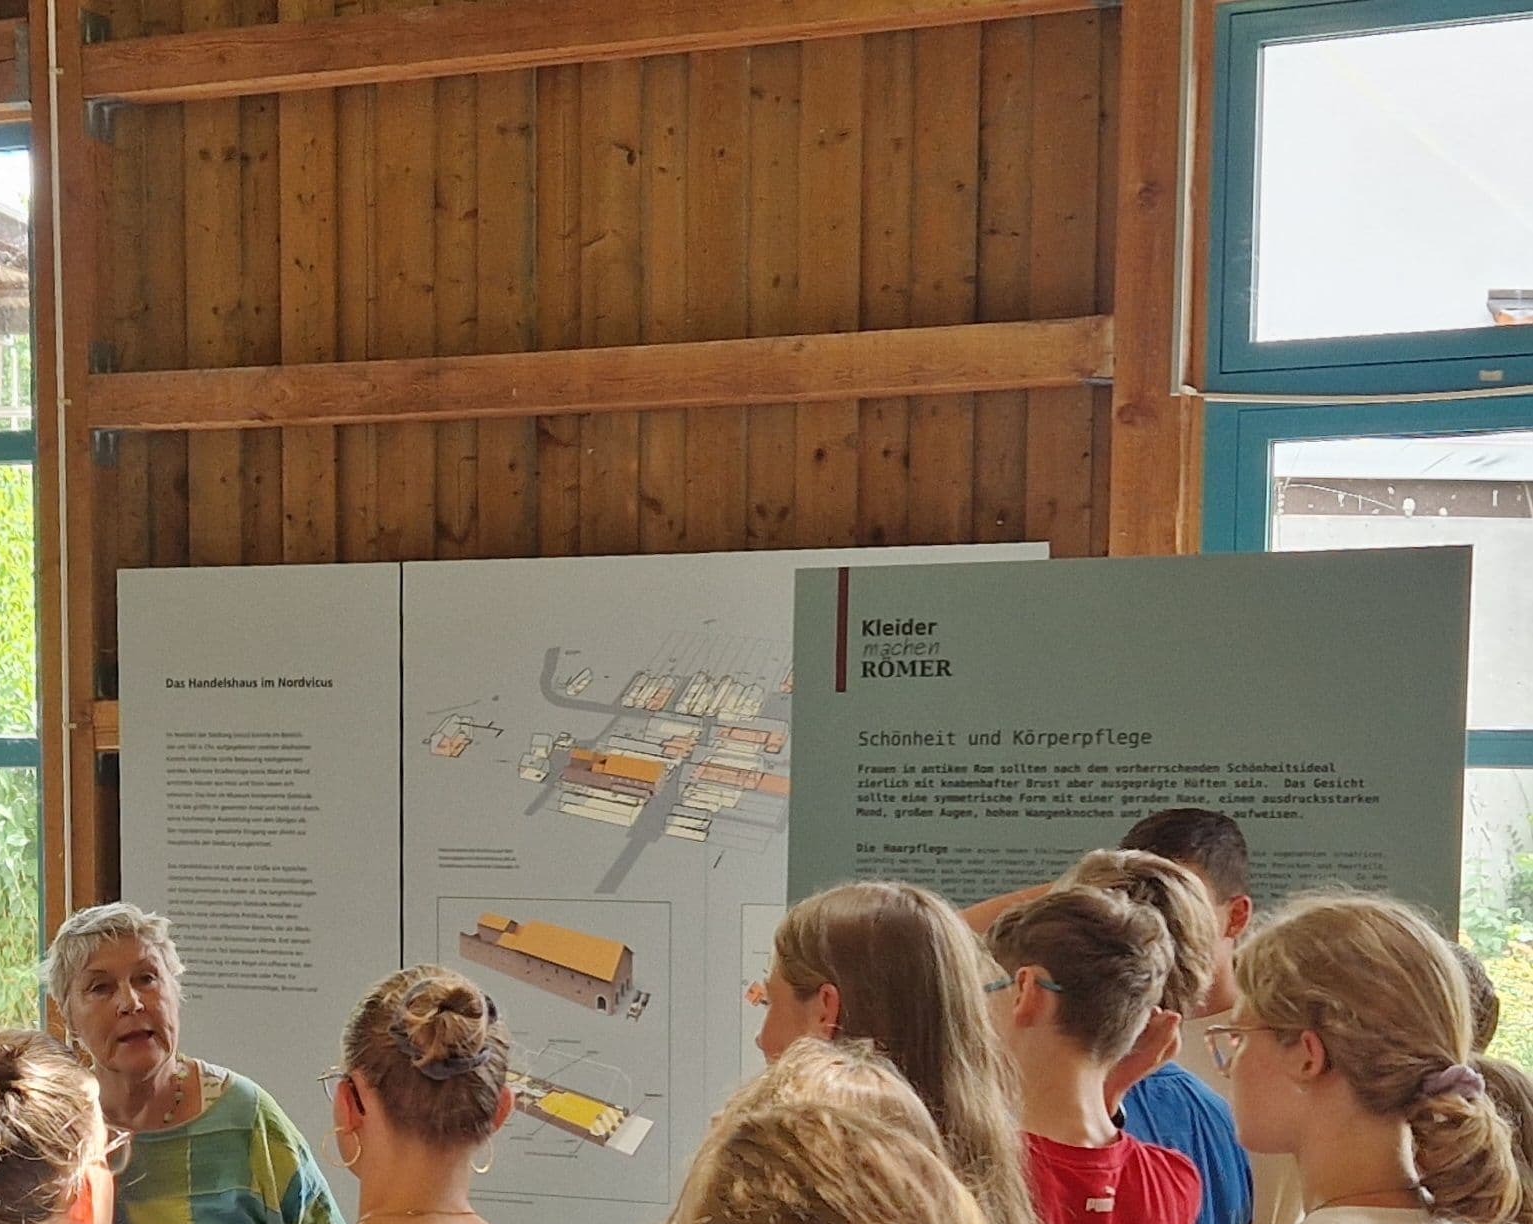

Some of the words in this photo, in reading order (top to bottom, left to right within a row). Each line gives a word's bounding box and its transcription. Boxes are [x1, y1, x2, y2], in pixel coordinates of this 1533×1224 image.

[861, 619, 938, 636] Kleider
[862, 639, 940, 656] machen
[860, 656, 952, 678] RÖMER
[166, 678, 185, 688] Das
[189, 678, 257, 688] Handelshaus
[261, 677, 274, 688] im
[278, 677, 333, 688] Nordvicus
[858, 731, 956, 746] Schönheit
[968, 730, 1001, 746] und
[1013, 728, 1152, 748] Körperpflege
[857, 764, 896, 774] Frauen
[921, 764, 968, 774] antiken
[1000, 764, 1047, 774] sollten
[1054, 764, 1080, 774] nach
[1088, 764, 1108, 773] dem
[1115, 763, 1220, 773] vorherrschenden
[1227, 762, 1335, 773] Schönheitsideal
[857, 779, 909, 789] zierlich
[915, 779, 934, 788] mit
[1026, 779, 1060, 788] Brust
[1067, 779, 1094, 788] aber
[1284, 779, 1306, 788] Das
[1314, 778, 1364, 789] Gesicht
[857, 793, 895, 802] sollte
[1052, 793, 1072, 803] mit
[856, 844, 876, 853] Die
[883, 844, 948, 855] Haarpflege
